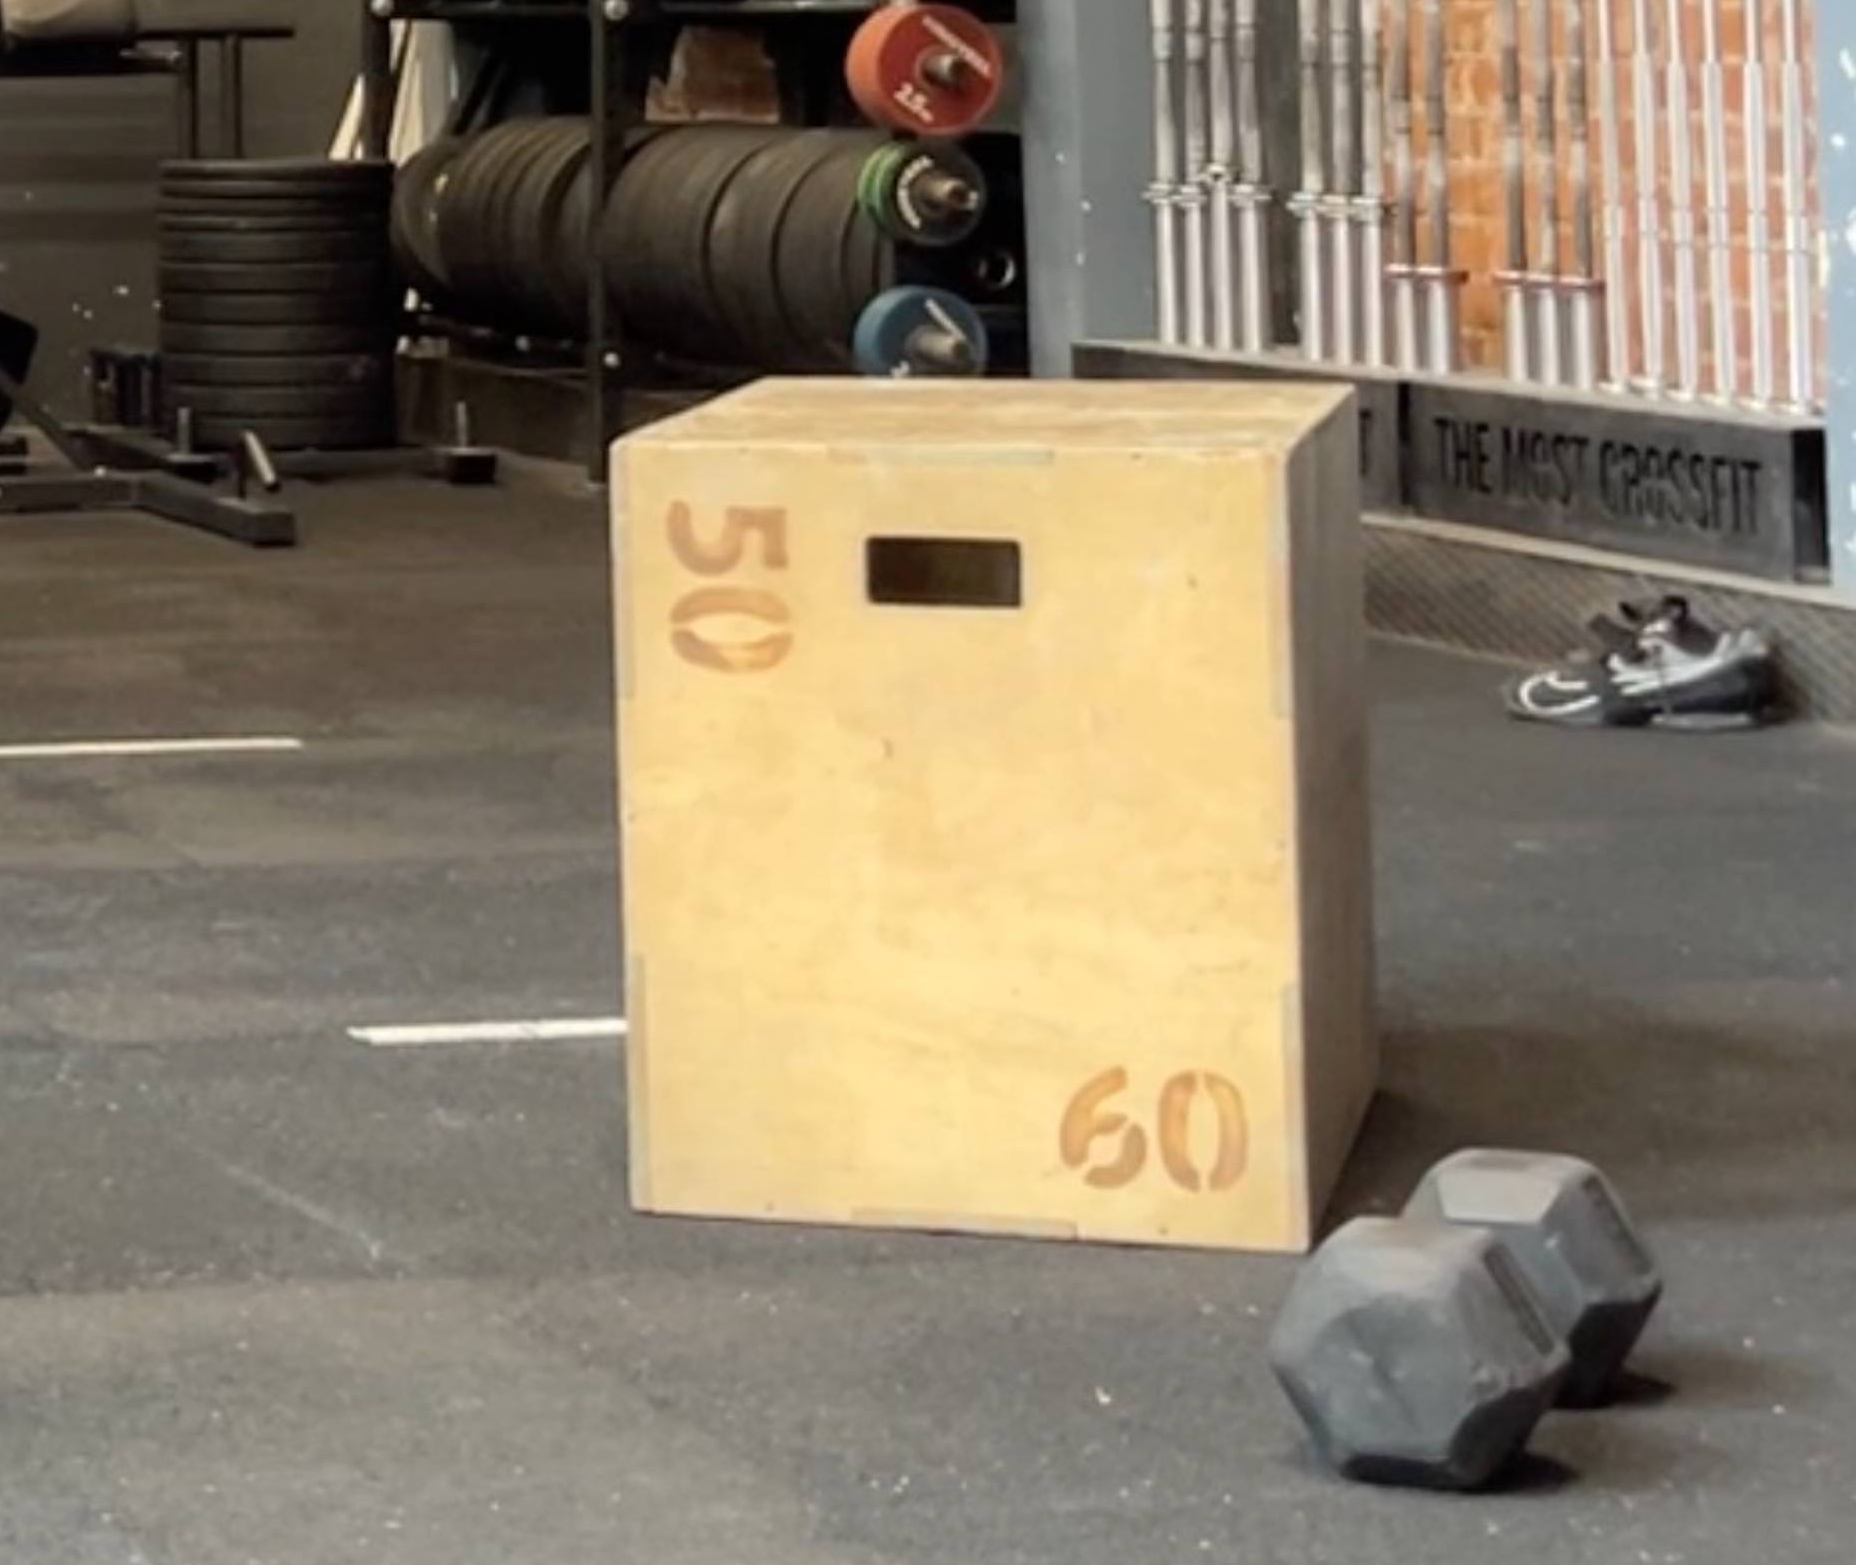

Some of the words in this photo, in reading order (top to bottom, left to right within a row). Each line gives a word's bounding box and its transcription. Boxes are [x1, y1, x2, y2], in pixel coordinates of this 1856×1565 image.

[1433, 416, 1493, 495] THE
[1501, 426, 1591, 507] MOST
[1598, 439, 1762, 535] CROSSFIT
[666, 499, 795, 675] 50
[1059, 1065, 1251, 1193] 60
